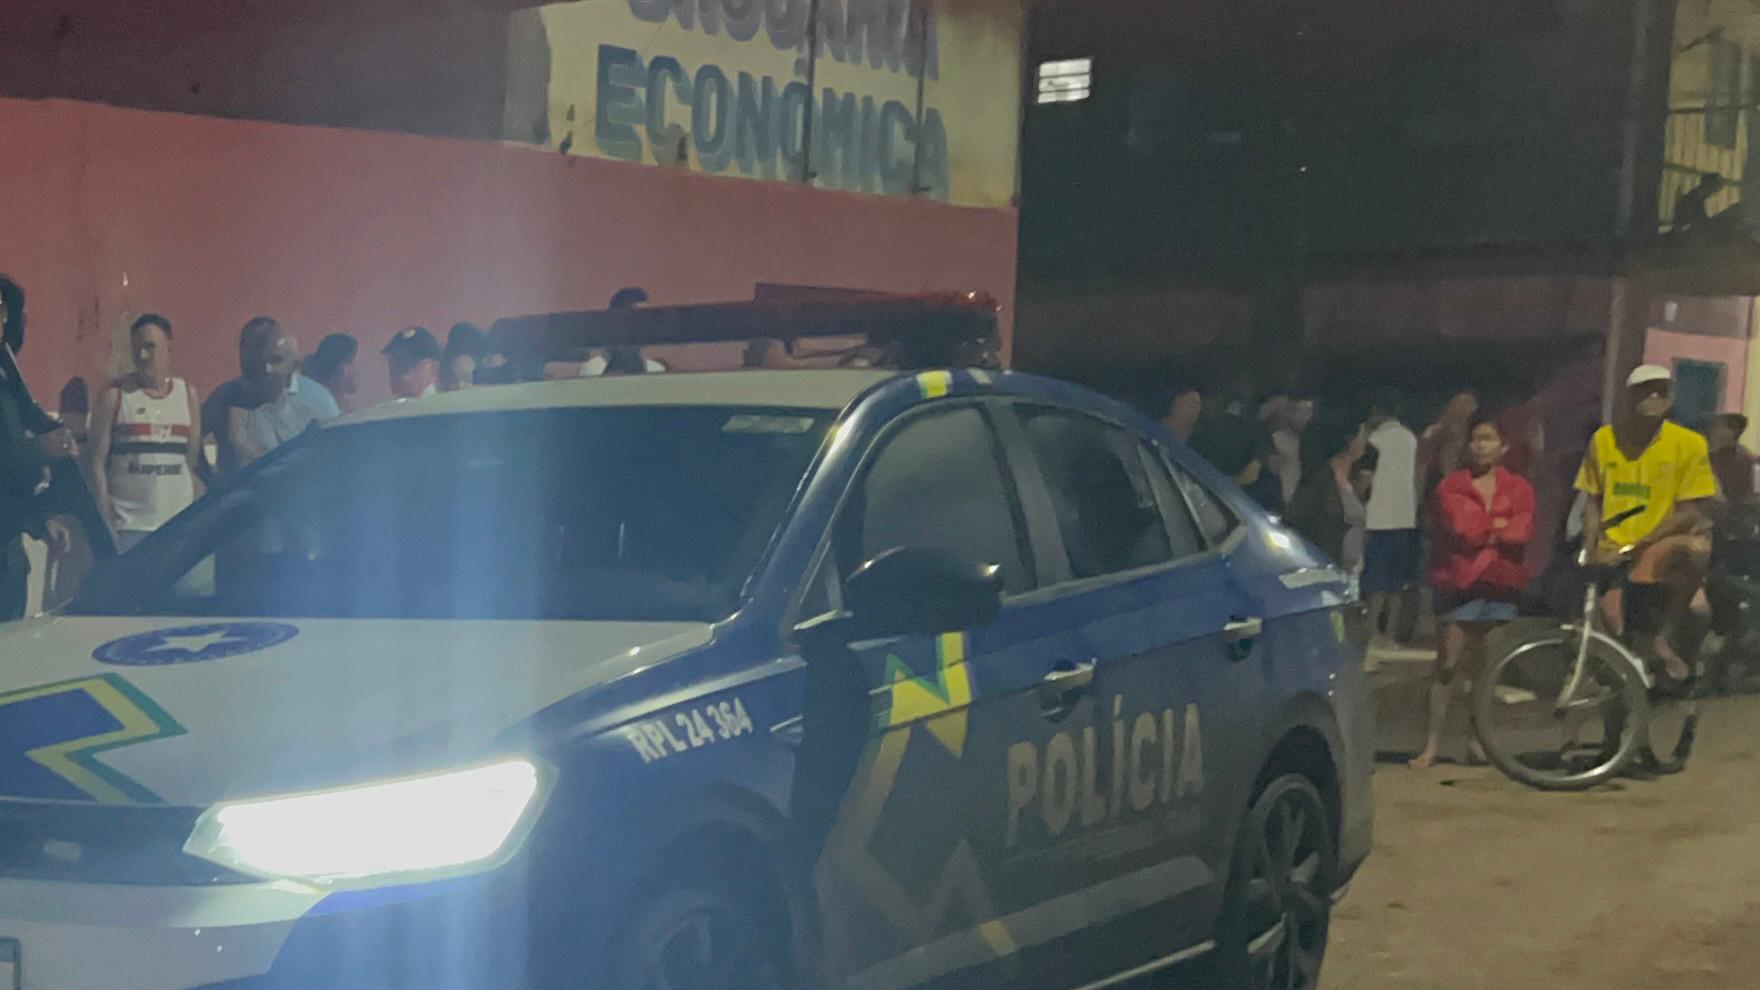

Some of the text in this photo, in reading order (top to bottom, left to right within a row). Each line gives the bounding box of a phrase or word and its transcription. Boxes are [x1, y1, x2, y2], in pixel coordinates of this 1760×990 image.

[625, 697, 753, 764] RPL 24 364
[1007, 694, 1204, 846] POLÍCIA
